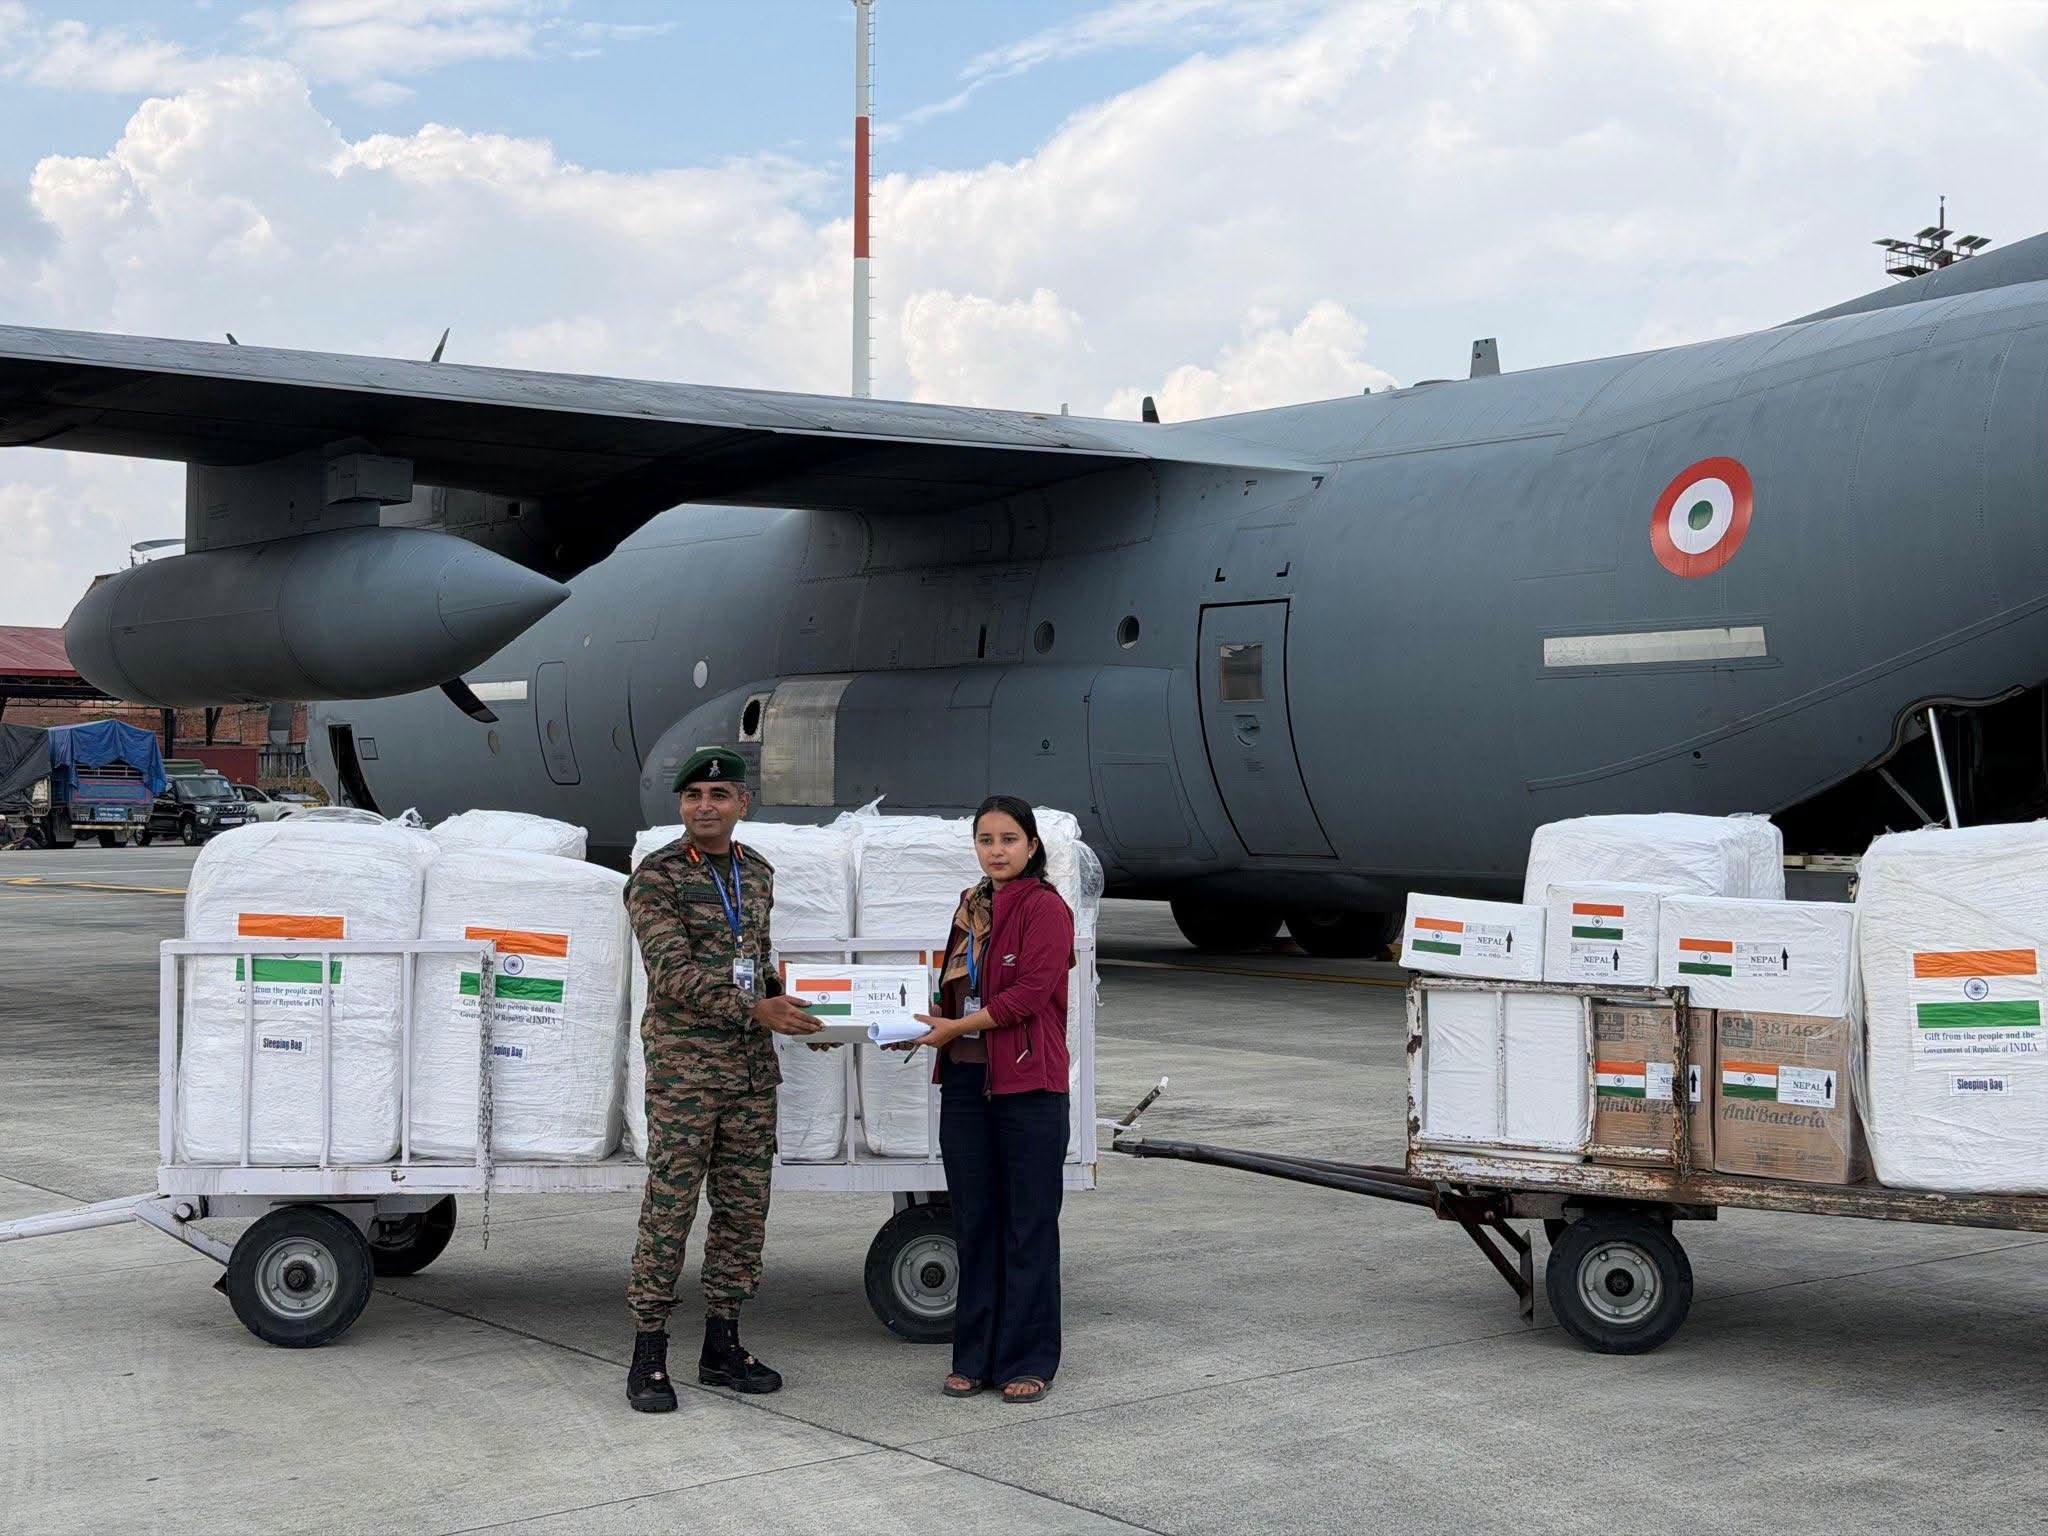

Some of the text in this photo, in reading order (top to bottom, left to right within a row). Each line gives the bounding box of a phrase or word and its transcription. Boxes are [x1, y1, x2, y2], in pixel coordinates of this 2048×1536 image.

[1477, 936, 1504, 946] NEPAL
[1584, 955, 1611, 964] NEPAL
[255, 985, 271, 994] from
[273, 986, 283, 994] the
[285, 986, 307, 996] people
[309, 986, 322, 995] and
[868, 992, 897, 1001] NEPAL
[462, 999, 476, 1007] Gift
[507, 1003, 529, 1012] people
[531, 1004, 543, 1013] and
[545, 1005, 556, 1014] the
[532, 1015, 556, 1025] INDIA
[1924, 1030, 2036, 1042] Gift from the people and the
[263, 1037, 303, 1051] Sleeping Bag
[1923, 1042, 2038, 1055] Government of Republic of INDIA
[511, 1045, 523, 1058] Bag
[1793, 1081, 1823, 1091] NEPAL
[1957, 1078, 2003, 1091] Sleeping Bag
[1722, 1103, 1826, 1128] AntiBacteria
